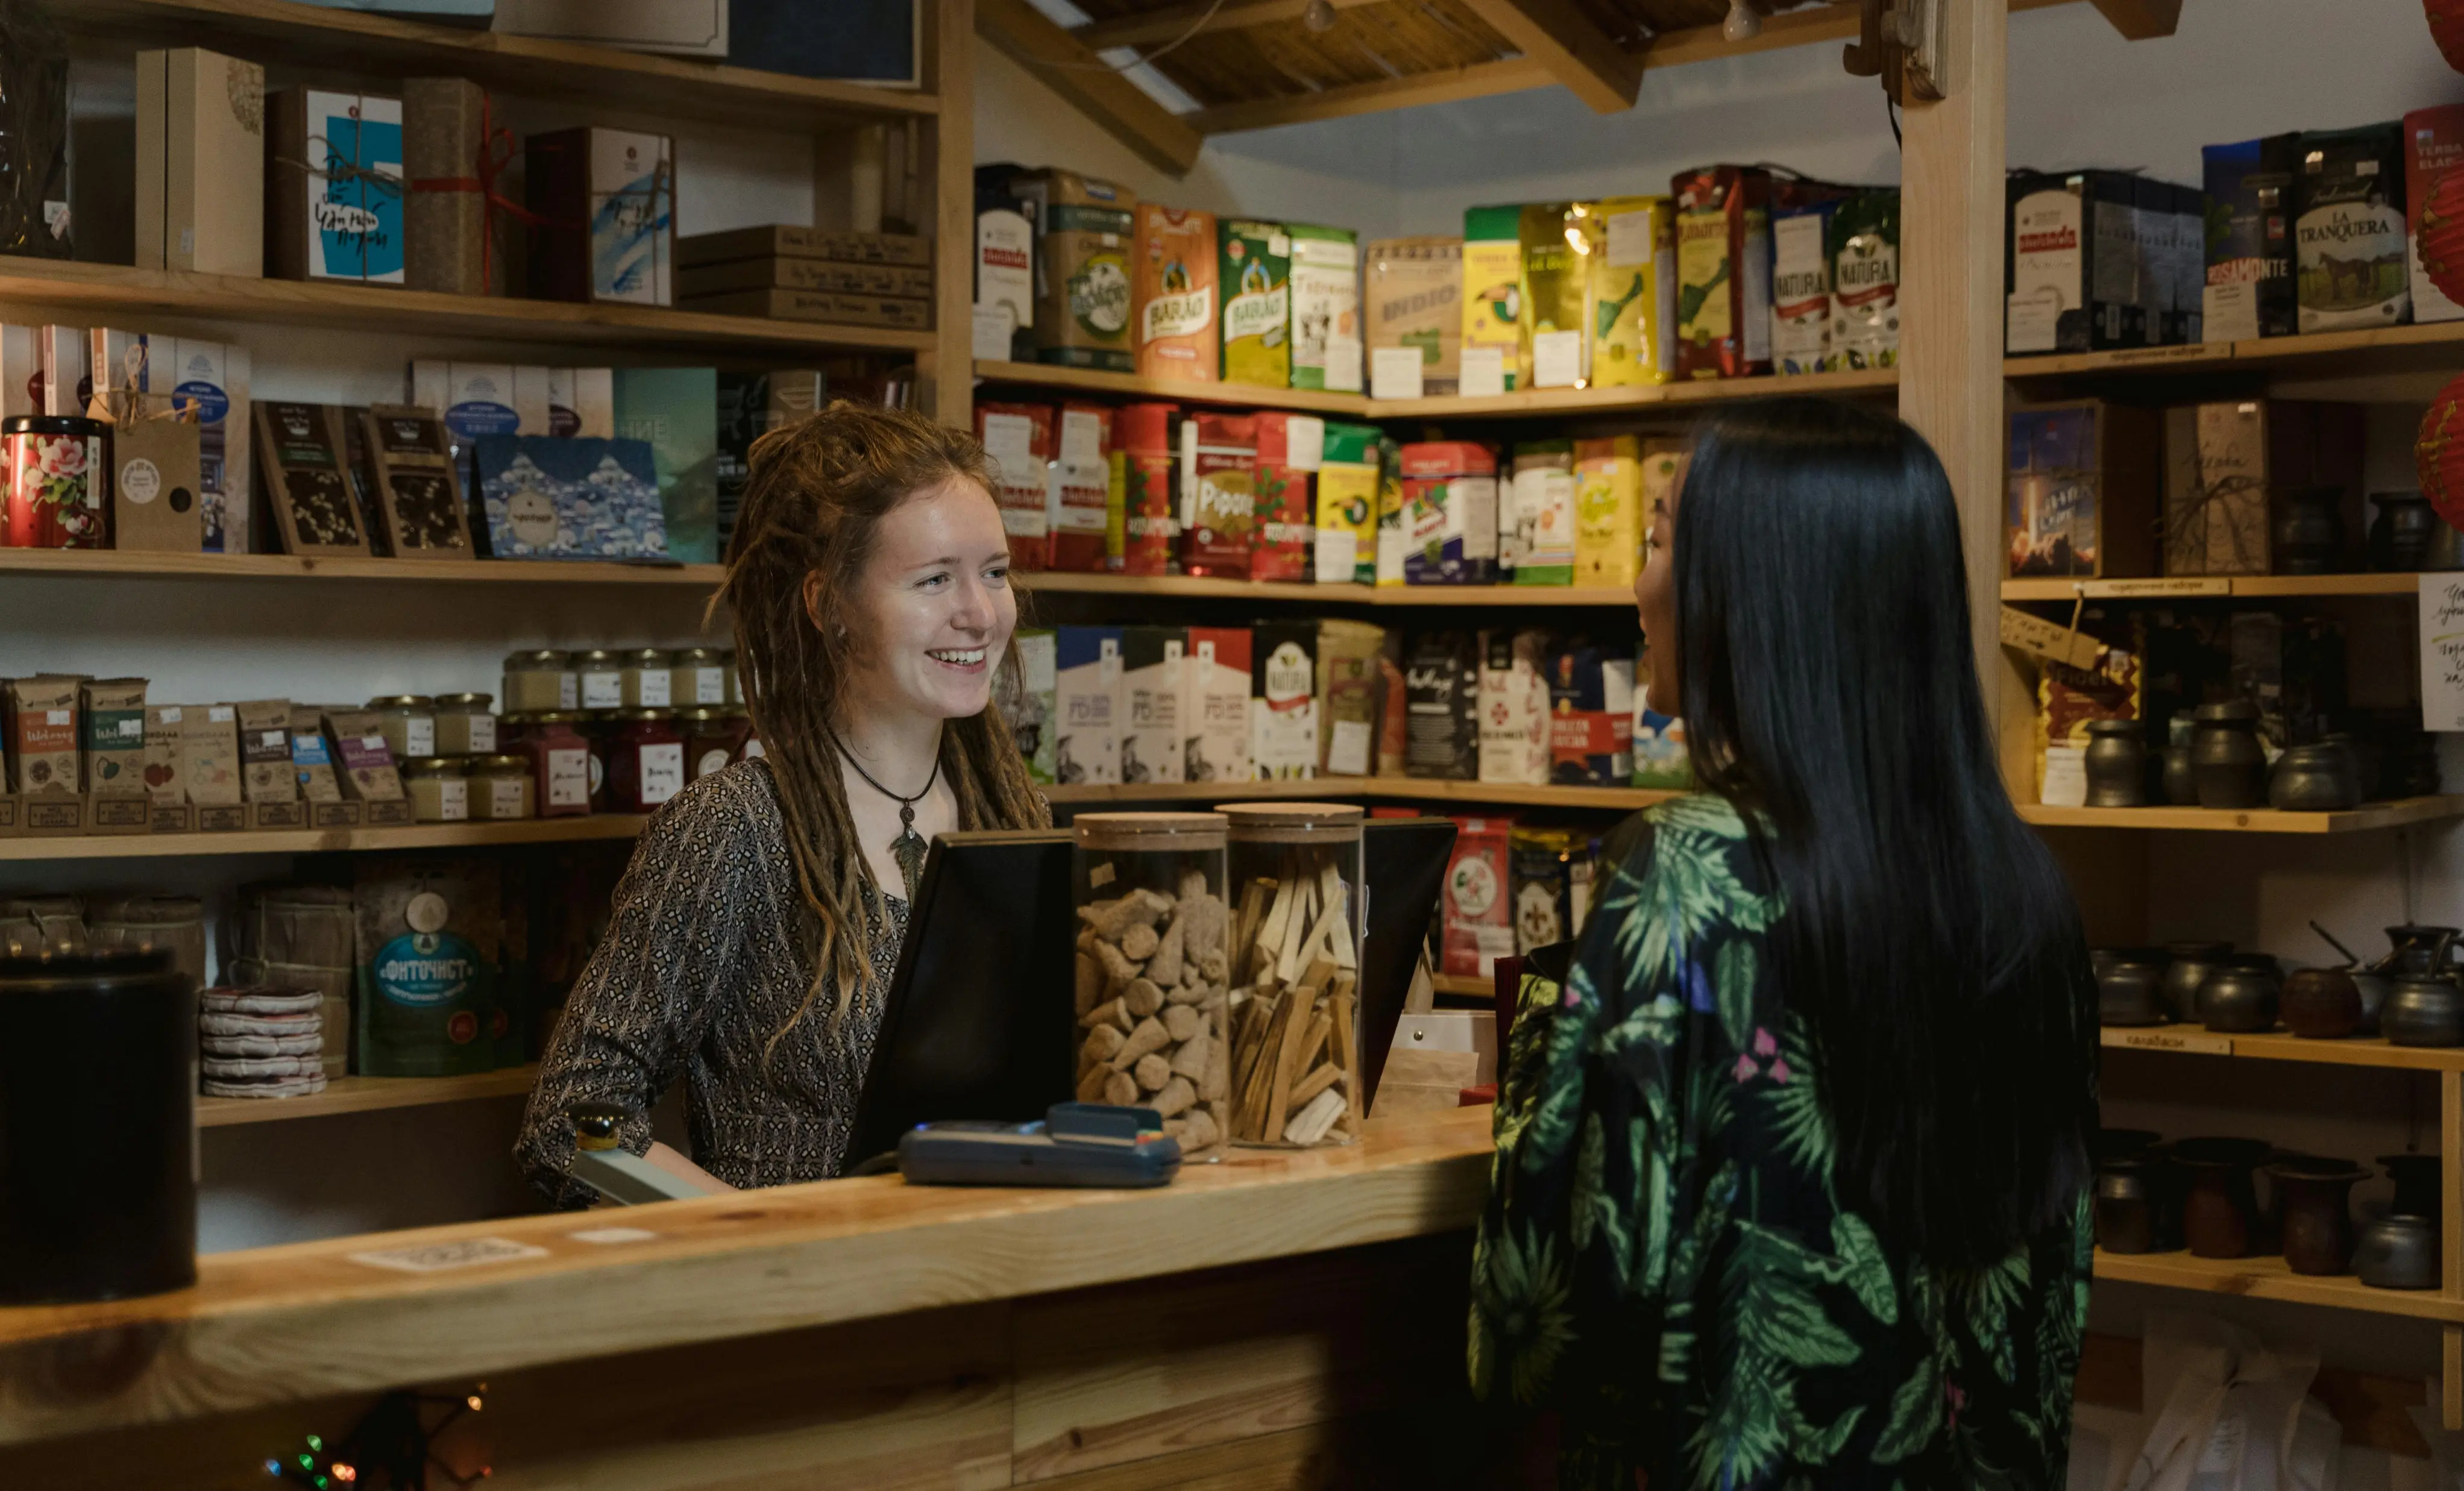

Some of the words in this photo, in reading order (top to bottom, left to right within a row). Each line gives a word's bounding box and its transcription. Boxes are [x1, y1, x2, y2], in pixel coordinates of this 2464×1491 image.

[2299, 219, 2390, 243] TRANQUERA
[2333, 212, 2349, 224] LA
[1840, 260, 1890, 286] NATURA
[2207, 257, 2289, 284] ROSAMONTE
[1775, 272, 1824, 298] NATURA
[1382, 284, 1457, 322] INDIO
